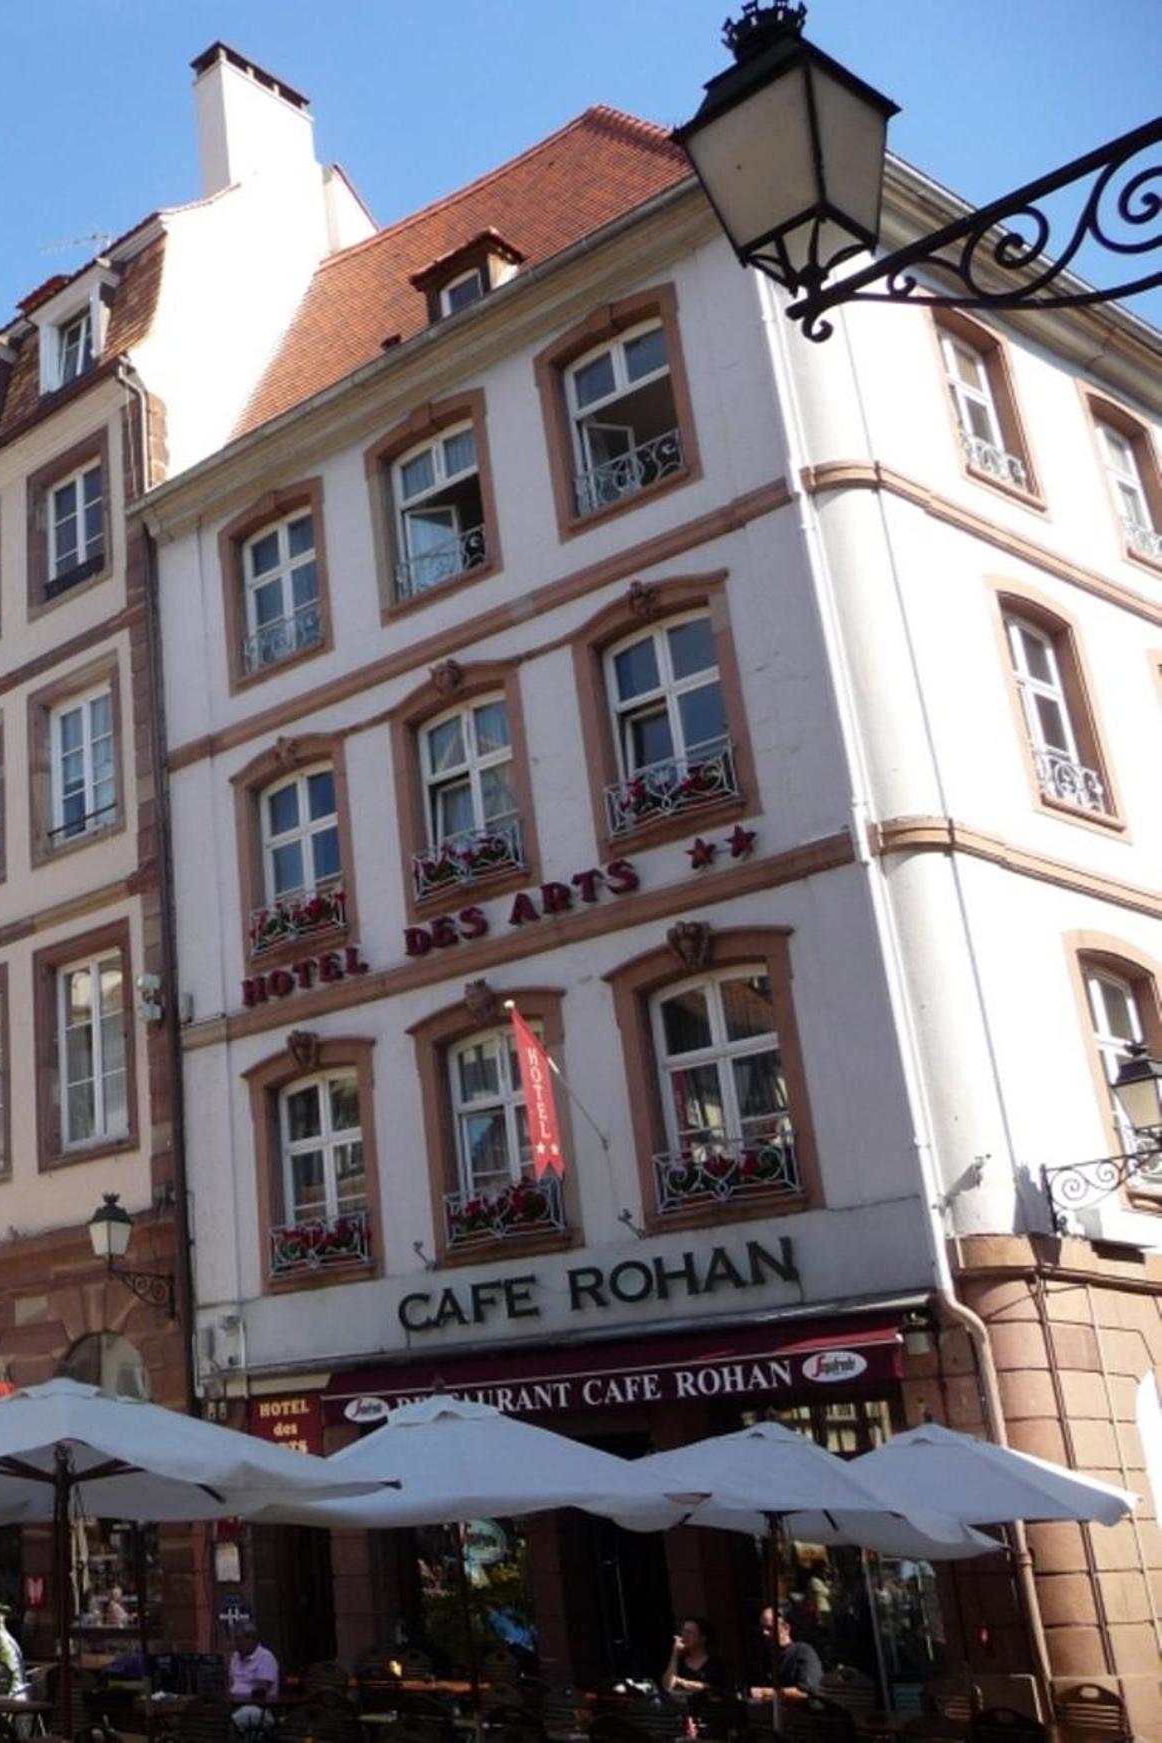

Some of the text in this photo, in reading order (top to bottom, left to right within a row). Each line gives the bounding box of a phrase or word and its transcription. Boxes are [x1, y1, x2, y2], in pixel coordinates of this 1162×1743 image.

[242, 859, 639, 1008] HOTEL DES ARTS
[527, 1047, 551, 1139] HOTEL
[398, 1236, 800, 1331] CAFE ROHAN
[259, 1399, 310, 1417] HOTEL
[397, 1382, 571, 1412] AURANT
[582, 1373, 662, 1406] CAFE
[675, 1360, 792, 1398] ROHAN
[273, 1422, 298, 1437] des
